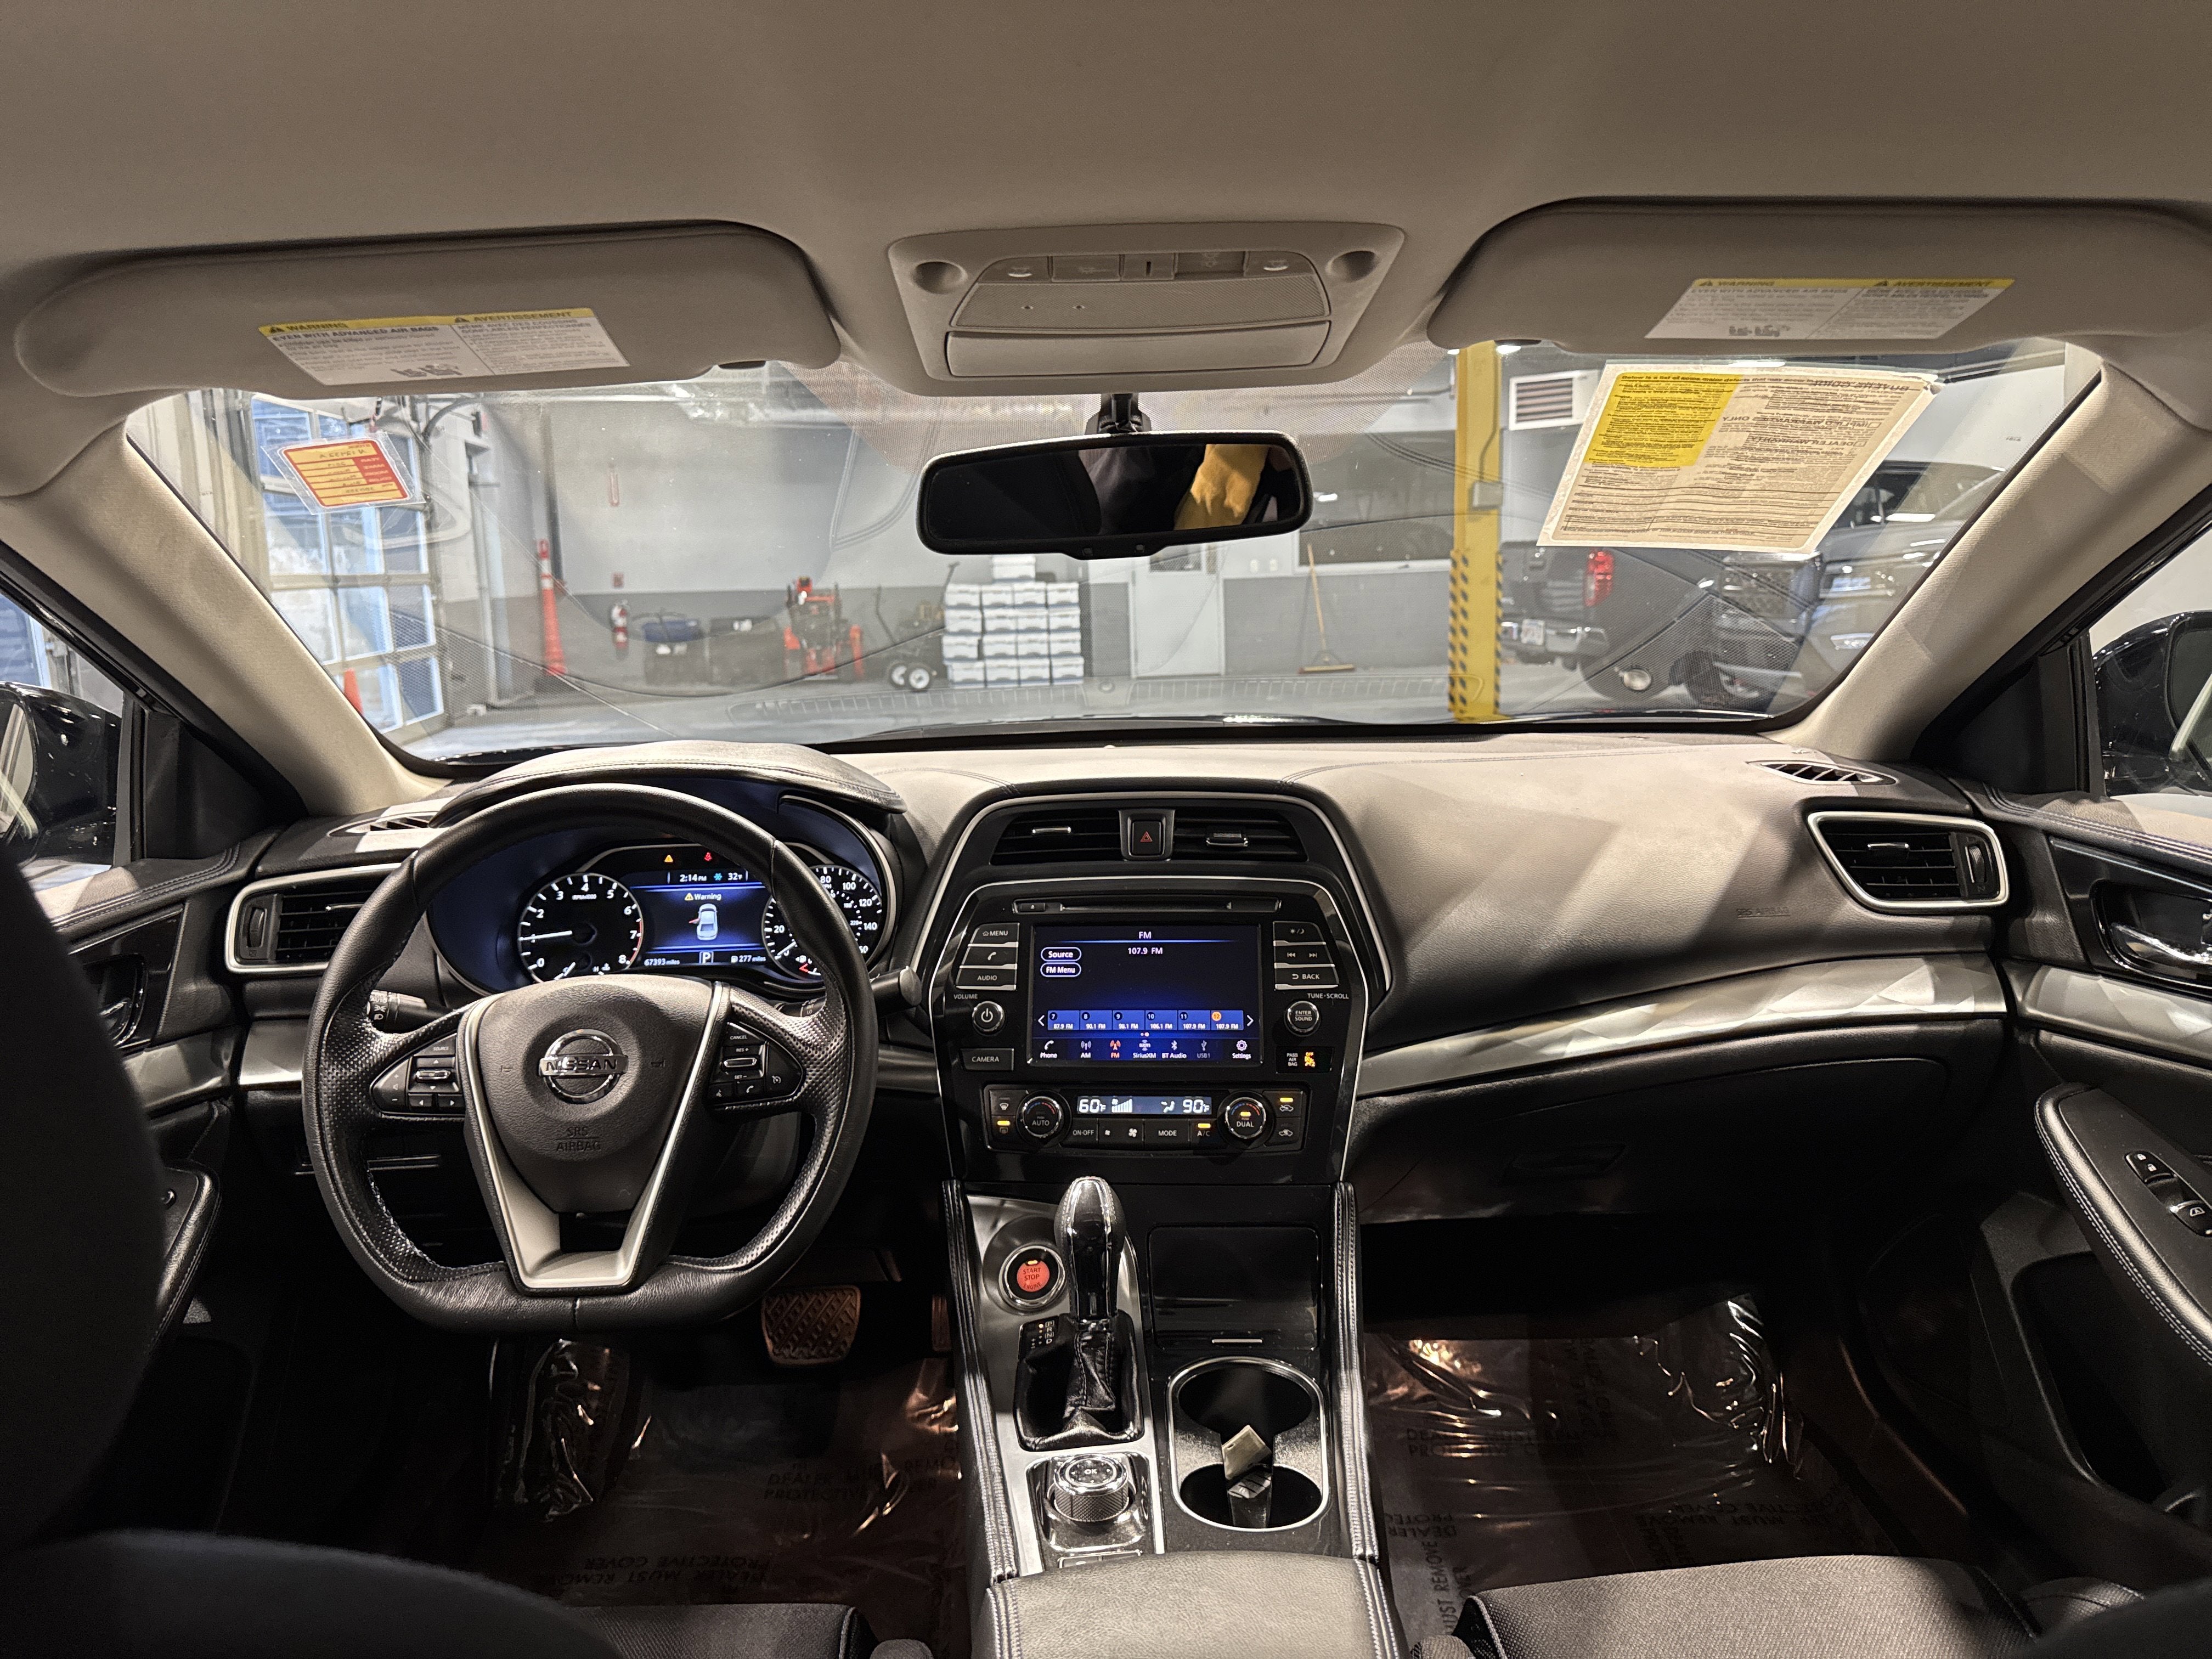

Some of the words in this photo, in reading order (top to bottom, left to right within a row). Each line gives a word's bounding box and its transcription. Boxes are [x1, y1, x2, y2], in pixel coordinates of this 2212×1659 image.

[332, 329, 387, 337] ADVANCED
[679, 873, 697, 882] 2:14
[581, 883, 589, 892] 4
[842, 882, 856, 890] 100
[556, 890, 563, 900] 3
[606, 889, 614, 899] 5
[694, 893, 721, 901] Warning
[859, 899, 872, 907] 120
[536, 909, 544, 918] 2
[623, 906, 631, 915] 6
[1755, 907, 1790, 915] AIRBAG
[774, 925, 785, 934] 20
[864, 922, 878, 930] 140
[629, 930, 637, 940] 7
[859, 945, 868, 953] 60
[702, 952, 711, 963] P
[1048, 950, 1074, 958] Source
[537, 958, 545, 967] 0
[618, 954, 627, 964] 8
[546, 1058, 618, 1071] NISSAN
[566, 1126, 589, 1137] SRS
[556, 1141, 602, 1152] AIRBAG
[1023, 1282, 1042, 1290] ENGINE
[1384, 1513, 1453, 1525] PROTEC
[1387, 1525, 1458, 1538] DEALER
[1421, 1541, 1451, 1592] REMOVE
